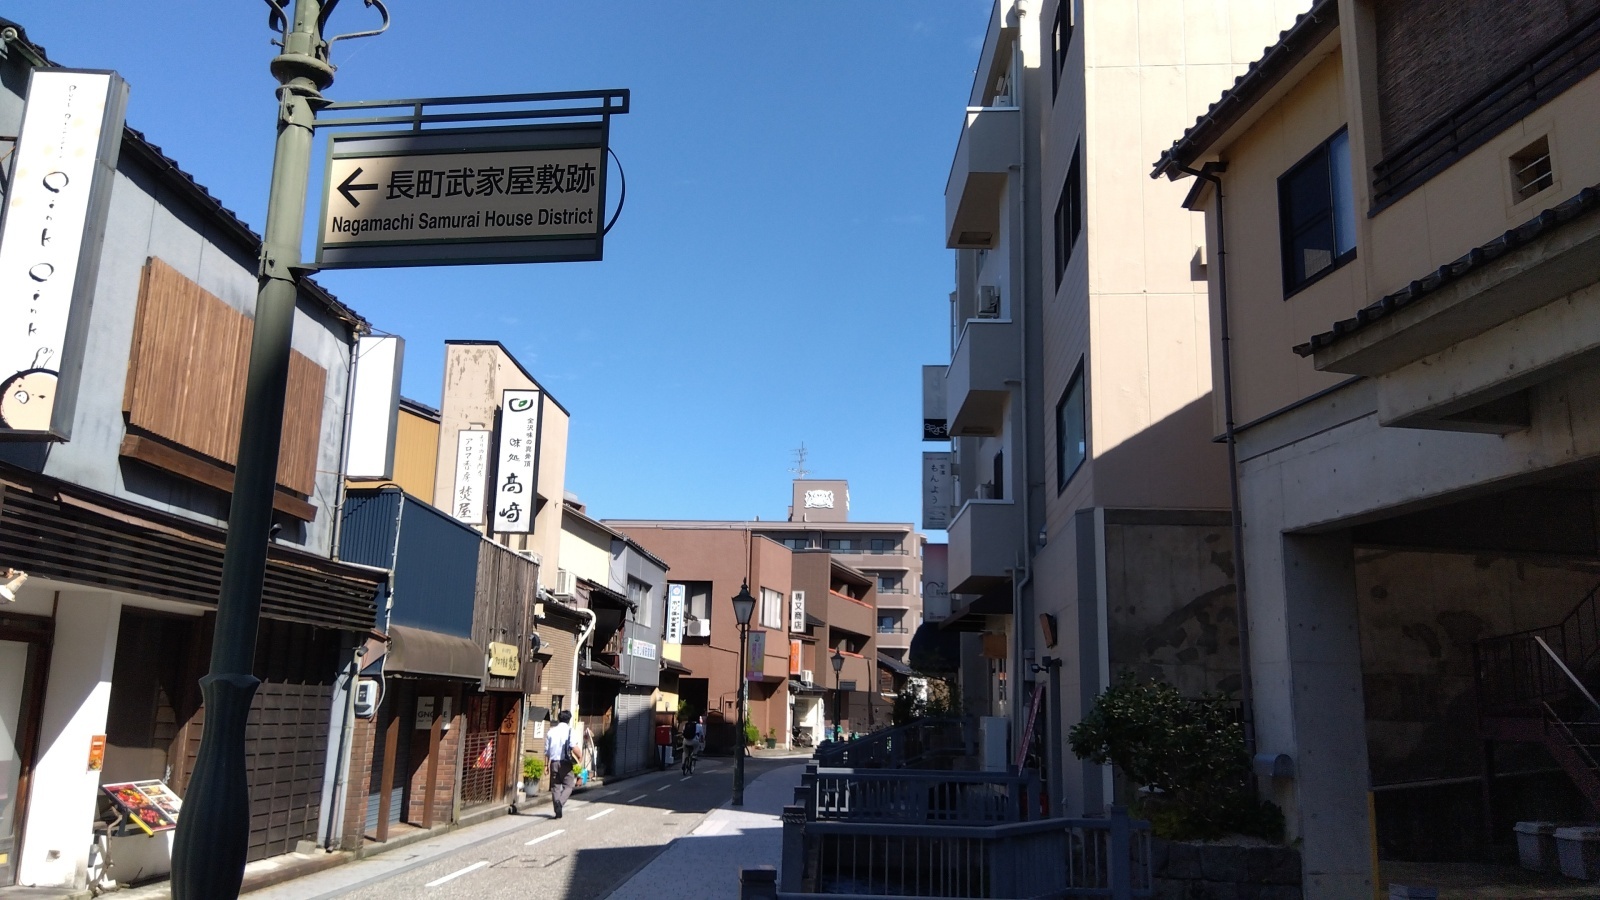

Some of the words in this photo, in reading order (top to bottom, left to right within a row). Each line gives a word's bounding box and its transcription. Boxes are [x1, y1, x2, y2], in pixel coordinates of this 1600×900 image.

[386, 163, 596, 200] 長町武家屋敷跡
[332, 213, 414, 236] Nagamachi
[418, 211, 480, 233] Samurai
[484, 209, 533, 227] House
[537, 208, 593, 225] District
